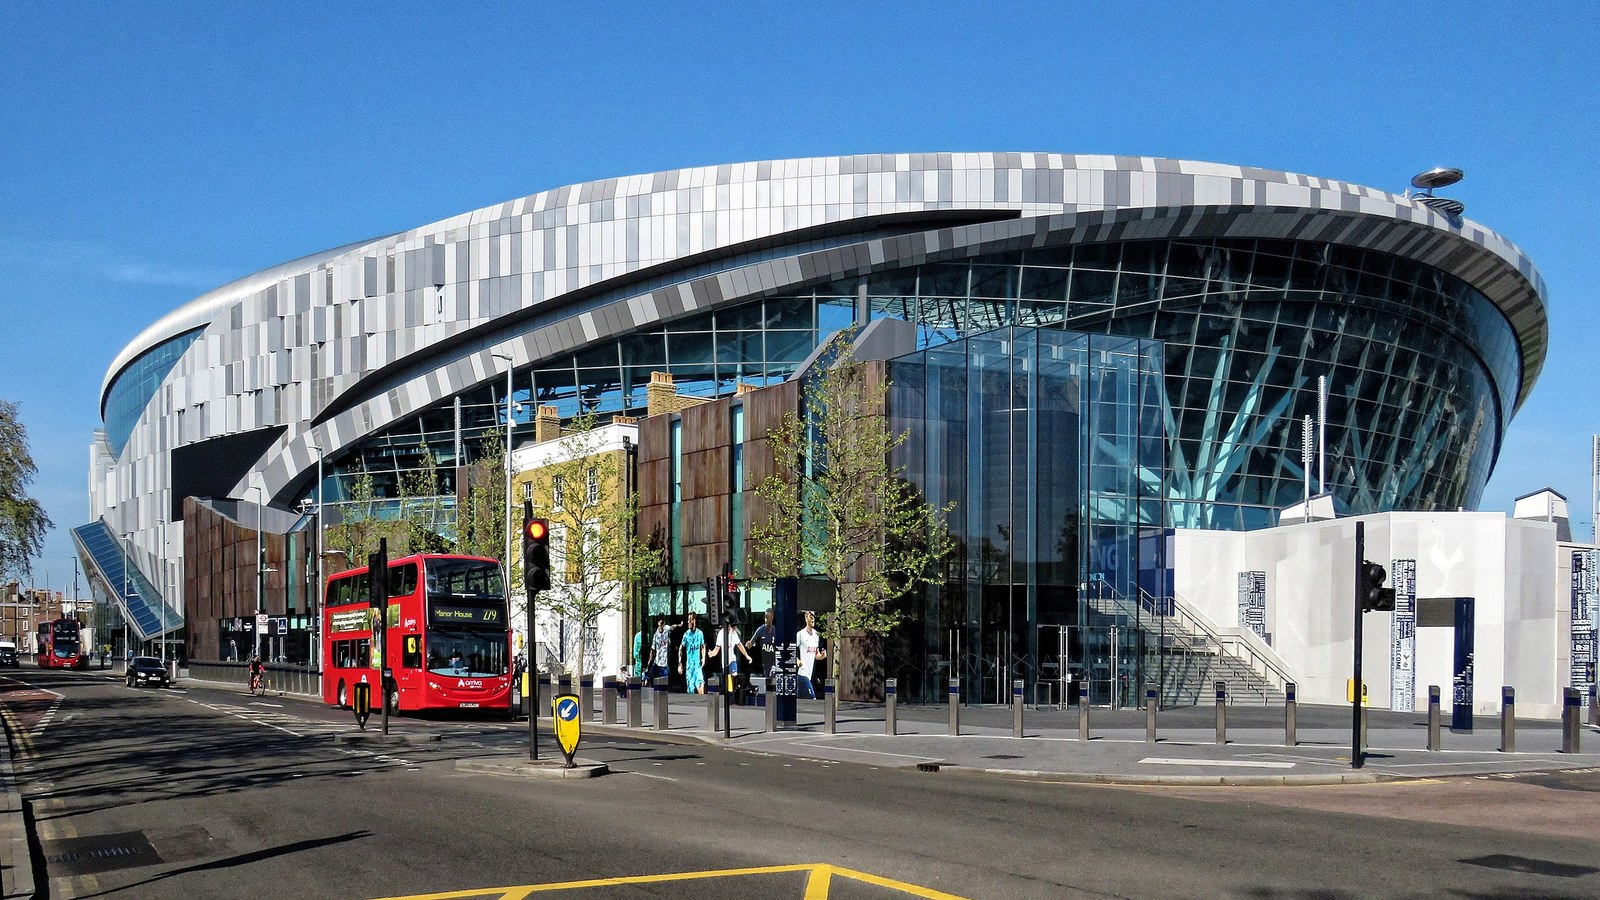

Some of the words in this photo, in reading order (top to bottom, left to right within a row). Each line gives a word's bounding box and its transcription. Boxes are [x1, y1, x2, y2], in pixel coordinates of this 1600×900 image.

[435, 609, 453, 617] Manor
[454, 610, 473, 618] House
[762, 643, 775, 652] AIA
